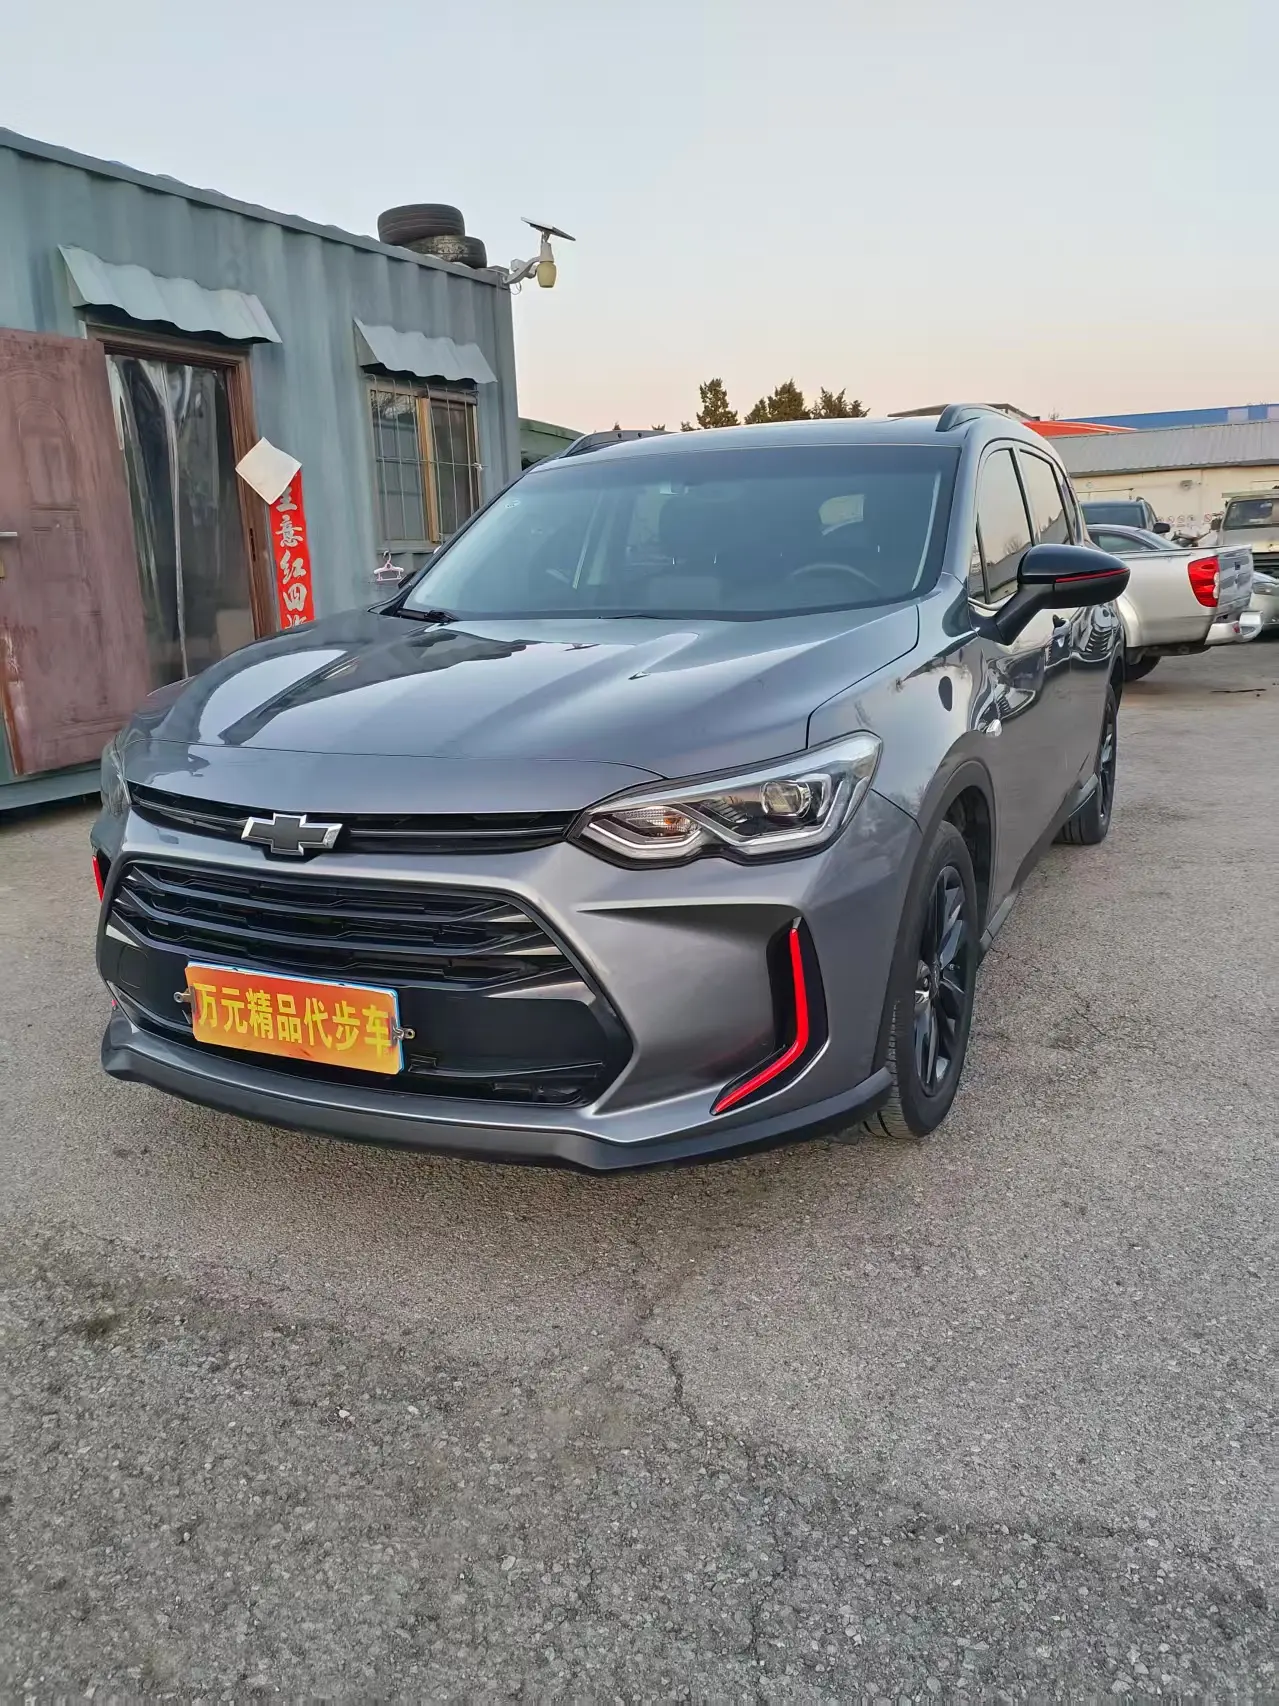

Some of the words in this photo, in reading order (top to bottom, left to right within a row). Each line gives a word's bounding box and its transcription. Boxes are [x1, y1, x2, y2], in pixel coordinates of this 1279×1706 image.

[193, 982, 392, 1060] 万元精品代步车
